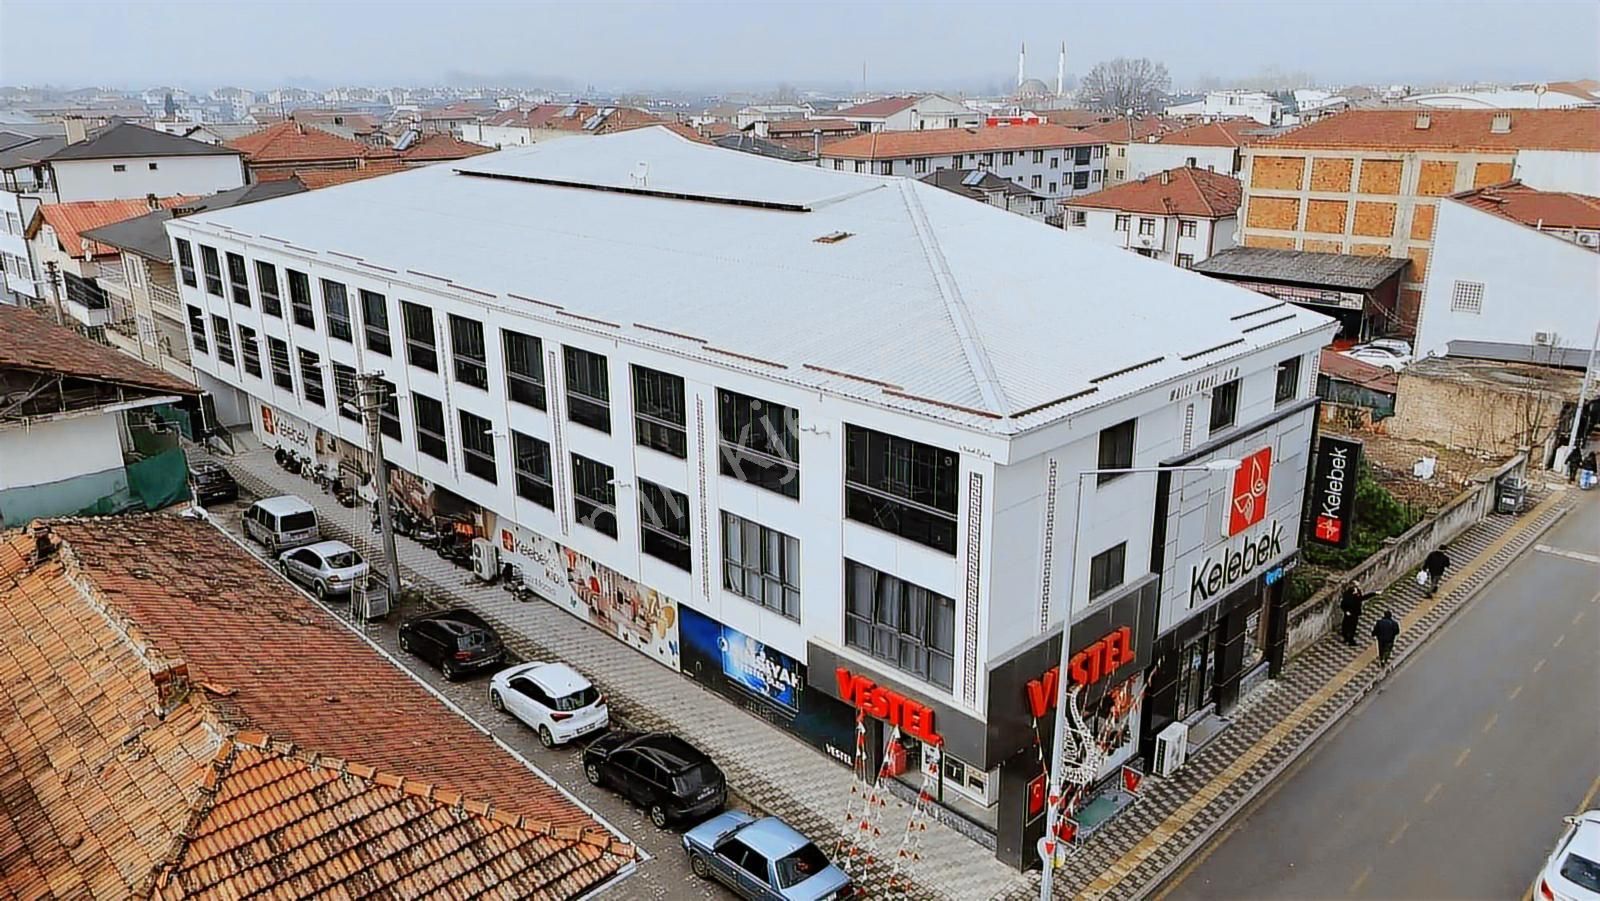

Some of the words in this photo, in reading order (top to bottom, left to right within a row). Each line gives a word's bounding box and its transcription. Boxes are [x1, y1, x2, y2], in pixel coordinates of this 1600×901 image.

[1321, 446, 1348, 519] Kelebek
[1189, 520, 1283, 609] Kelebek
[835, 667, 944, 746] VESTEL
[825, 743, 854, 766] VESTEL
